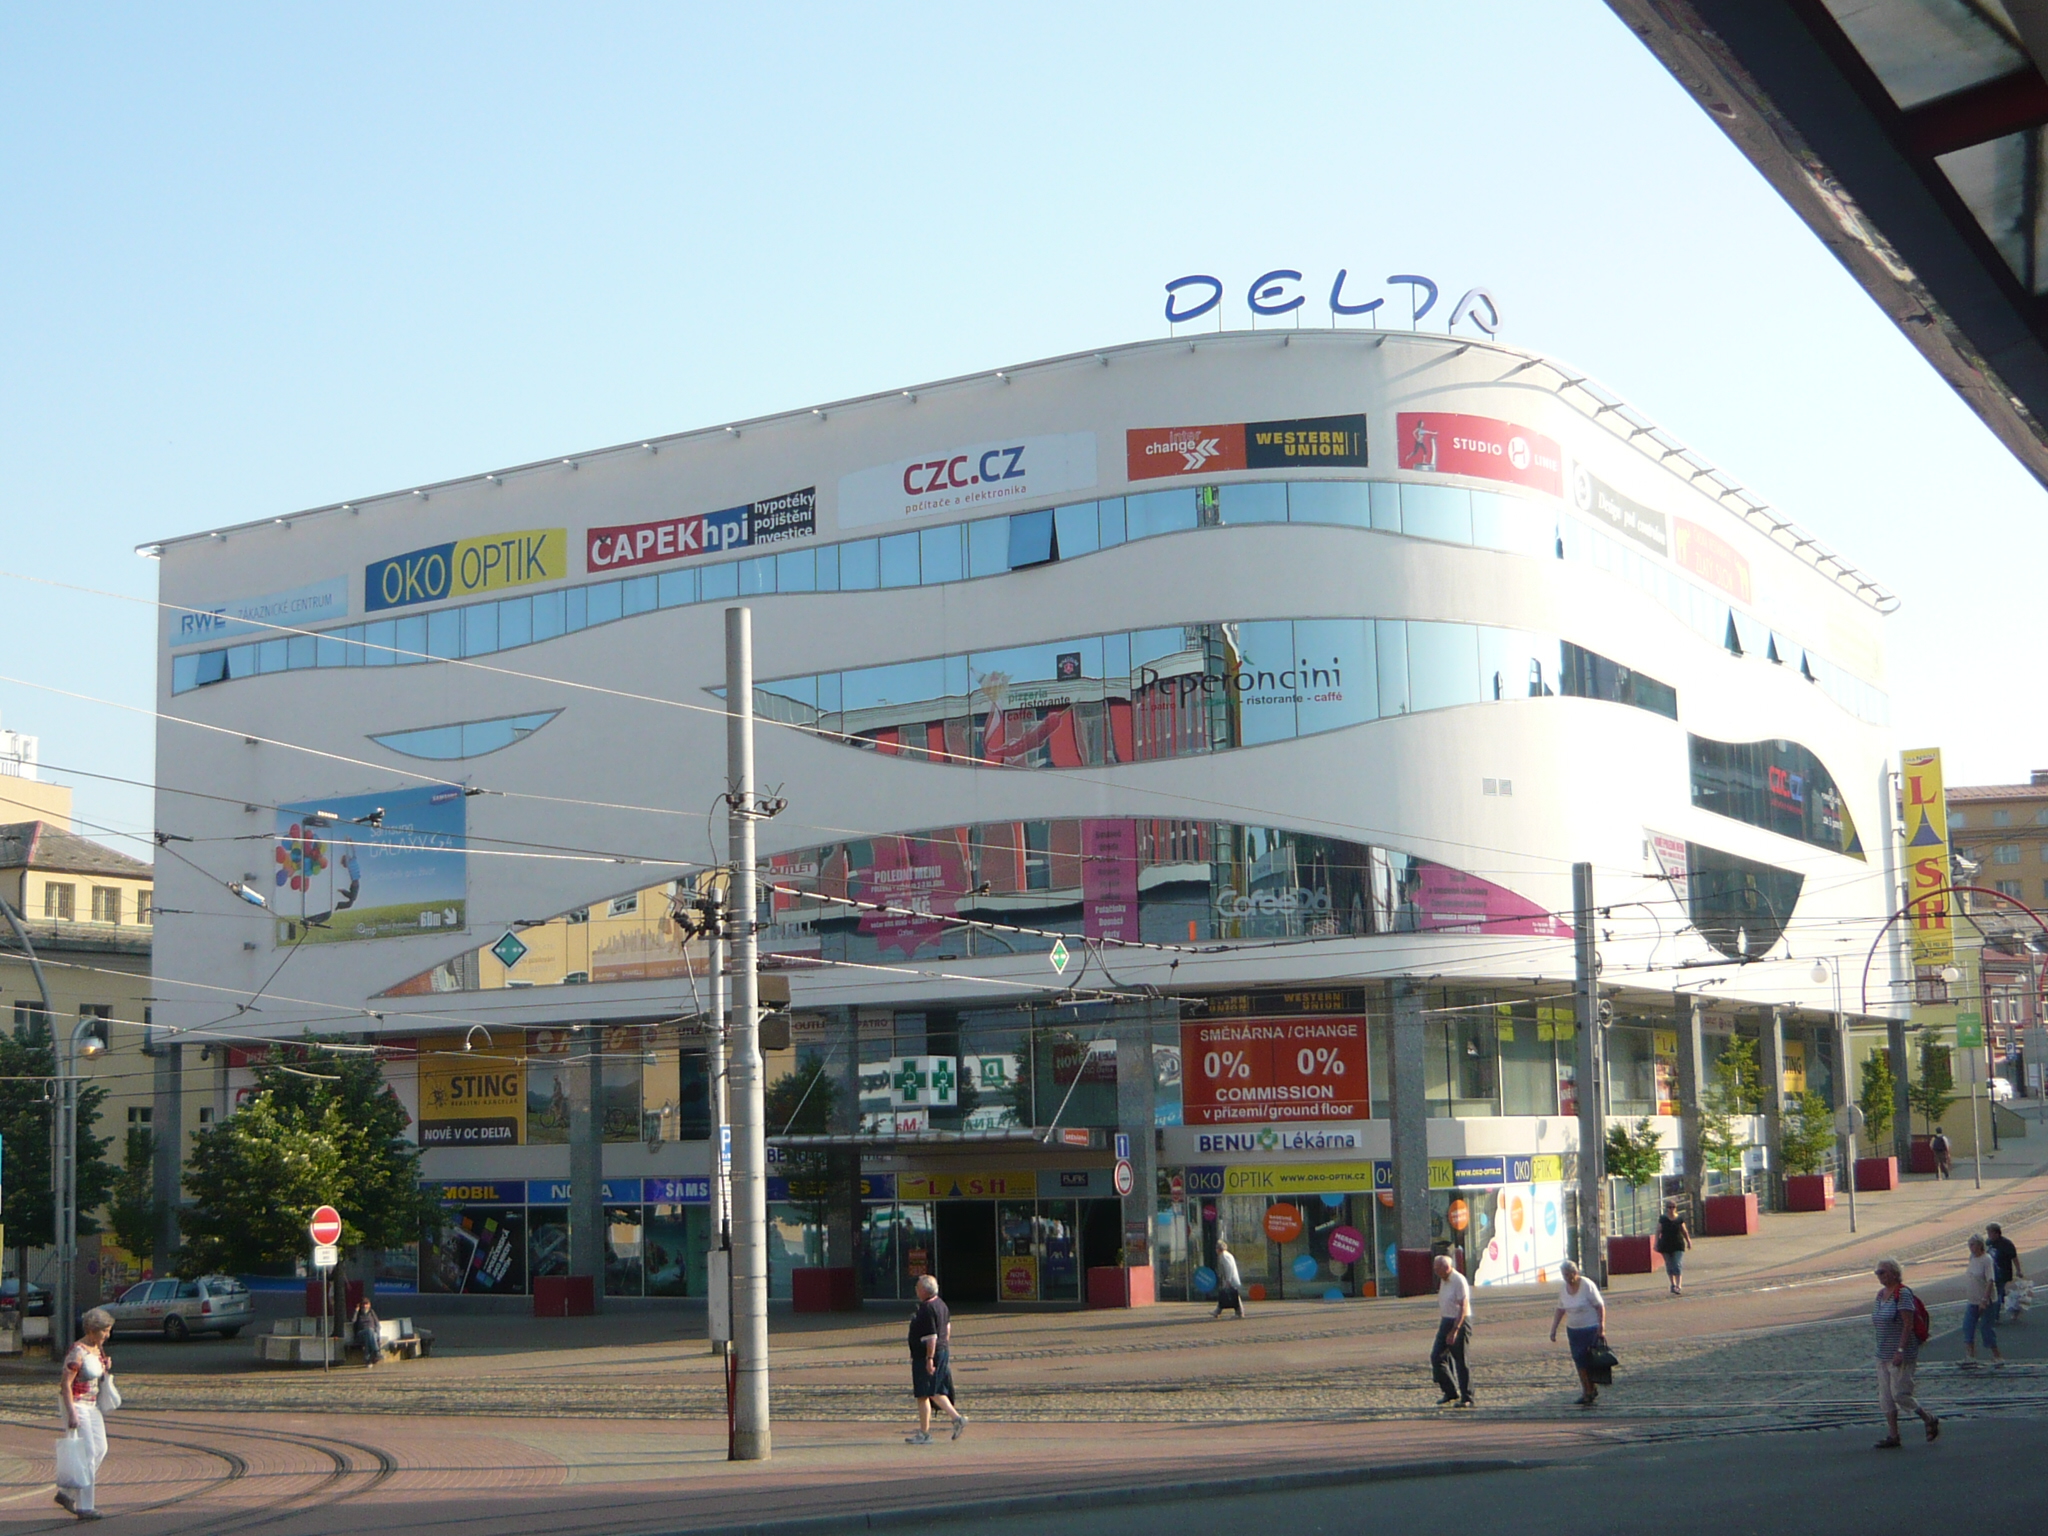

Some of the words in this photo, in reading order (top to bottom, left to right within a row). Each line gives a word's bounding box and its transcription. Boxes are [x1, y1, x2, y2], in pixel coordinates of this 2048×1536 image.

[1169, 430, 1201, 442] inter
[1256, 432, 1344, 444] WESTERN
[1145, 440, 1196, 455] change
[1284, 444, 1345, 456] UNION
[1453, 437, 1502, 456] STUDIO
[903, 446, 1026, 495] CZC.CZ
[754, 493, 815, 513] hypotéky
[905, 499, 950, 515] počítače
[965, 485, 1027, 502] elektronika
[754, 508, 812, 531] pojištění
[754, 526, 813, 545] investice
[382, 554, 446, 604] OKO
[460, 534, 547, 589] OPTIK
[181, 608, 226, 632] RWE
[291, 594, 332, 612] CENTRUM
[1141, 657, 1341, 708] Peperoncini
[1008, 689, 1048, 703] pizzeria
[1020, 696, 1070, 709] ristorante
[1247, 694, 1303, 705] ristorante
[1284, 993, 1342, 1003] WESTERN
[1303, 1002, 1342, 1011] UNION
[1200, 1025, 1284, 1042] SMĚNÁRNA
[1204, 1051, 1250, 1078] 0%
[1297, 1048, 1345, 1075] 0%
[451, 1074, 518, 1098] STING
[1216, 1085, 1333, 1101] COMMISSION
[1203, 1110, 1211, 1118] v
[1321, 1103, 1353, 1117] floor
[454, 1127, 463, 1139] V
[464, 1127, 478, 1139] OC
[481, 1126, 512, 1138] DELTA
[1200, 1134, 1255, 1152] BENU
[1283, 1131, 1355, 1150] Lékárna
[1514, 1160, 1530, 1180] OKO
[1532, 1160, 1552, 1178] OPTIK
[1189, 1172, 1221, 1188] OKO
[1229, 1171, 1274, 1188] OPTIK
